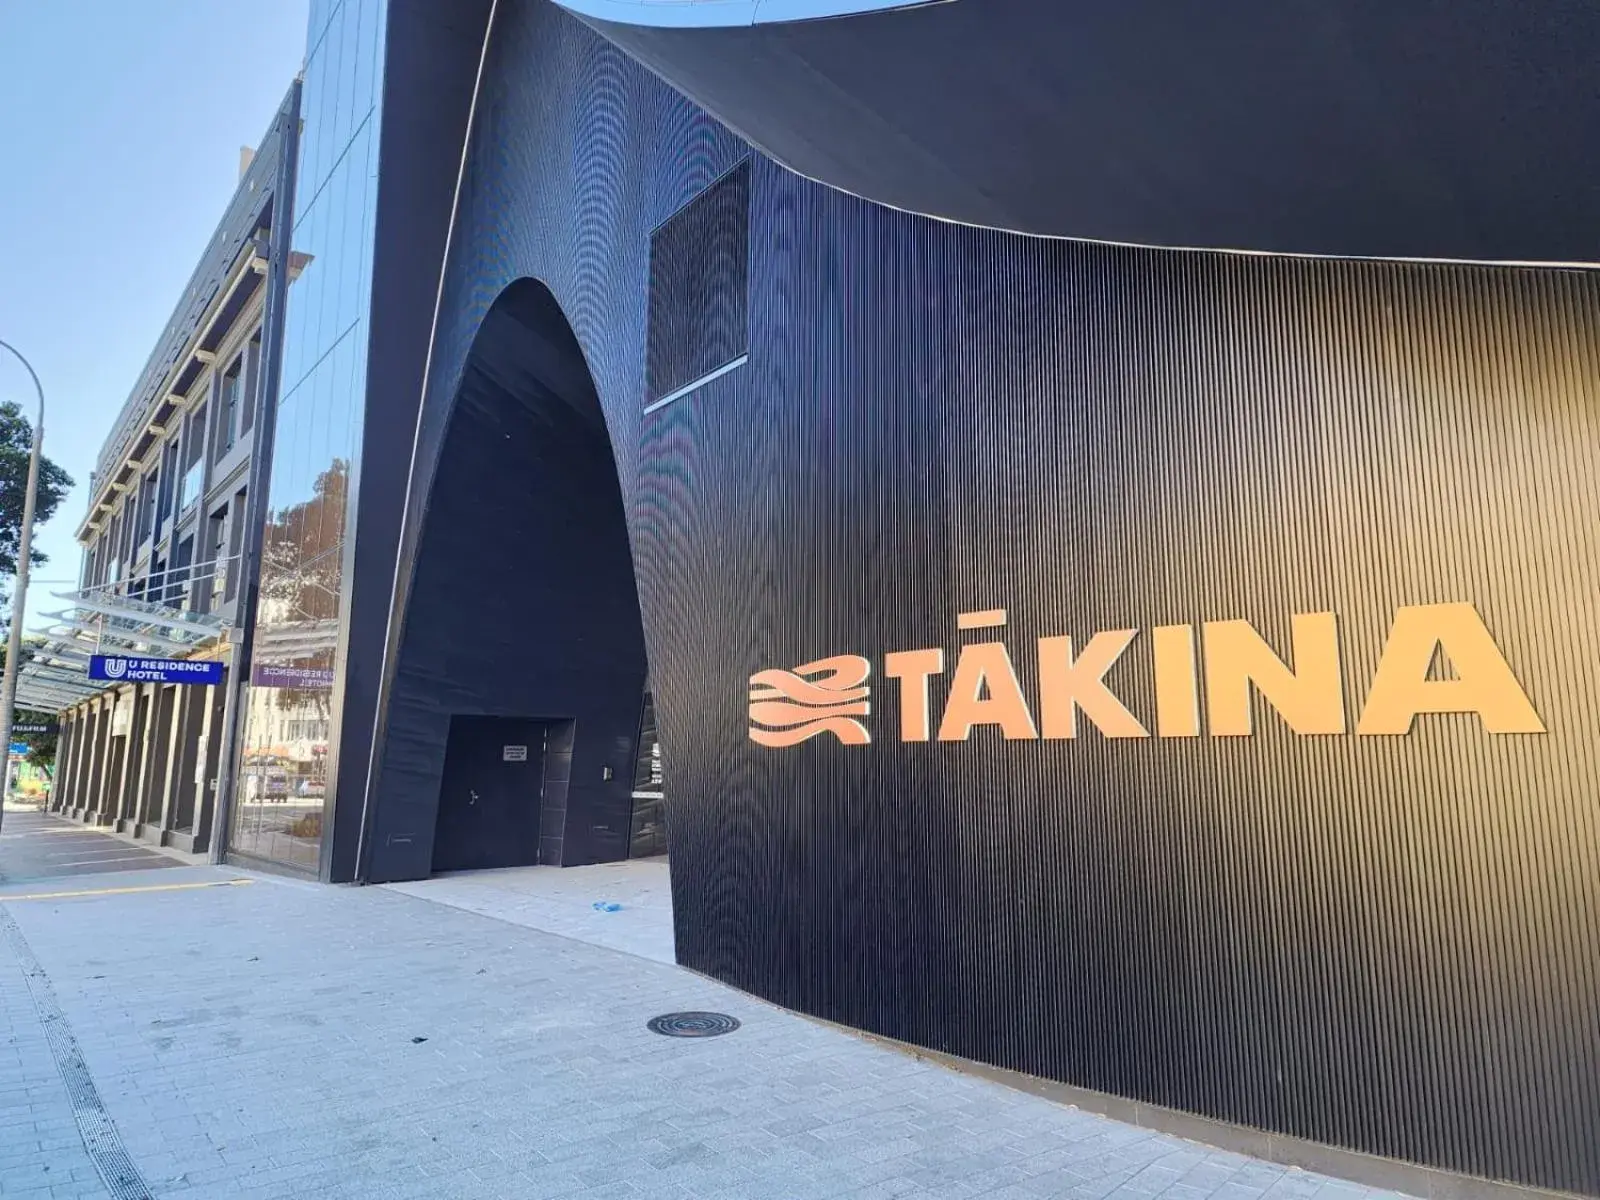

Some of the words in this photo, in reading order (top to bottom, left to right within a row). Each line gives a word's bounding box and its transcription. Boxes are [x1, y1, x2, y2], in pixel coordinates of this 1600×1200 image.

[129, 660, 137, 669] U
[141, 661, 210, 672] RESIDENCE
[127, 671, 167, 680] HOTEL
[885, 602, 1547, 743] TĀKINA
